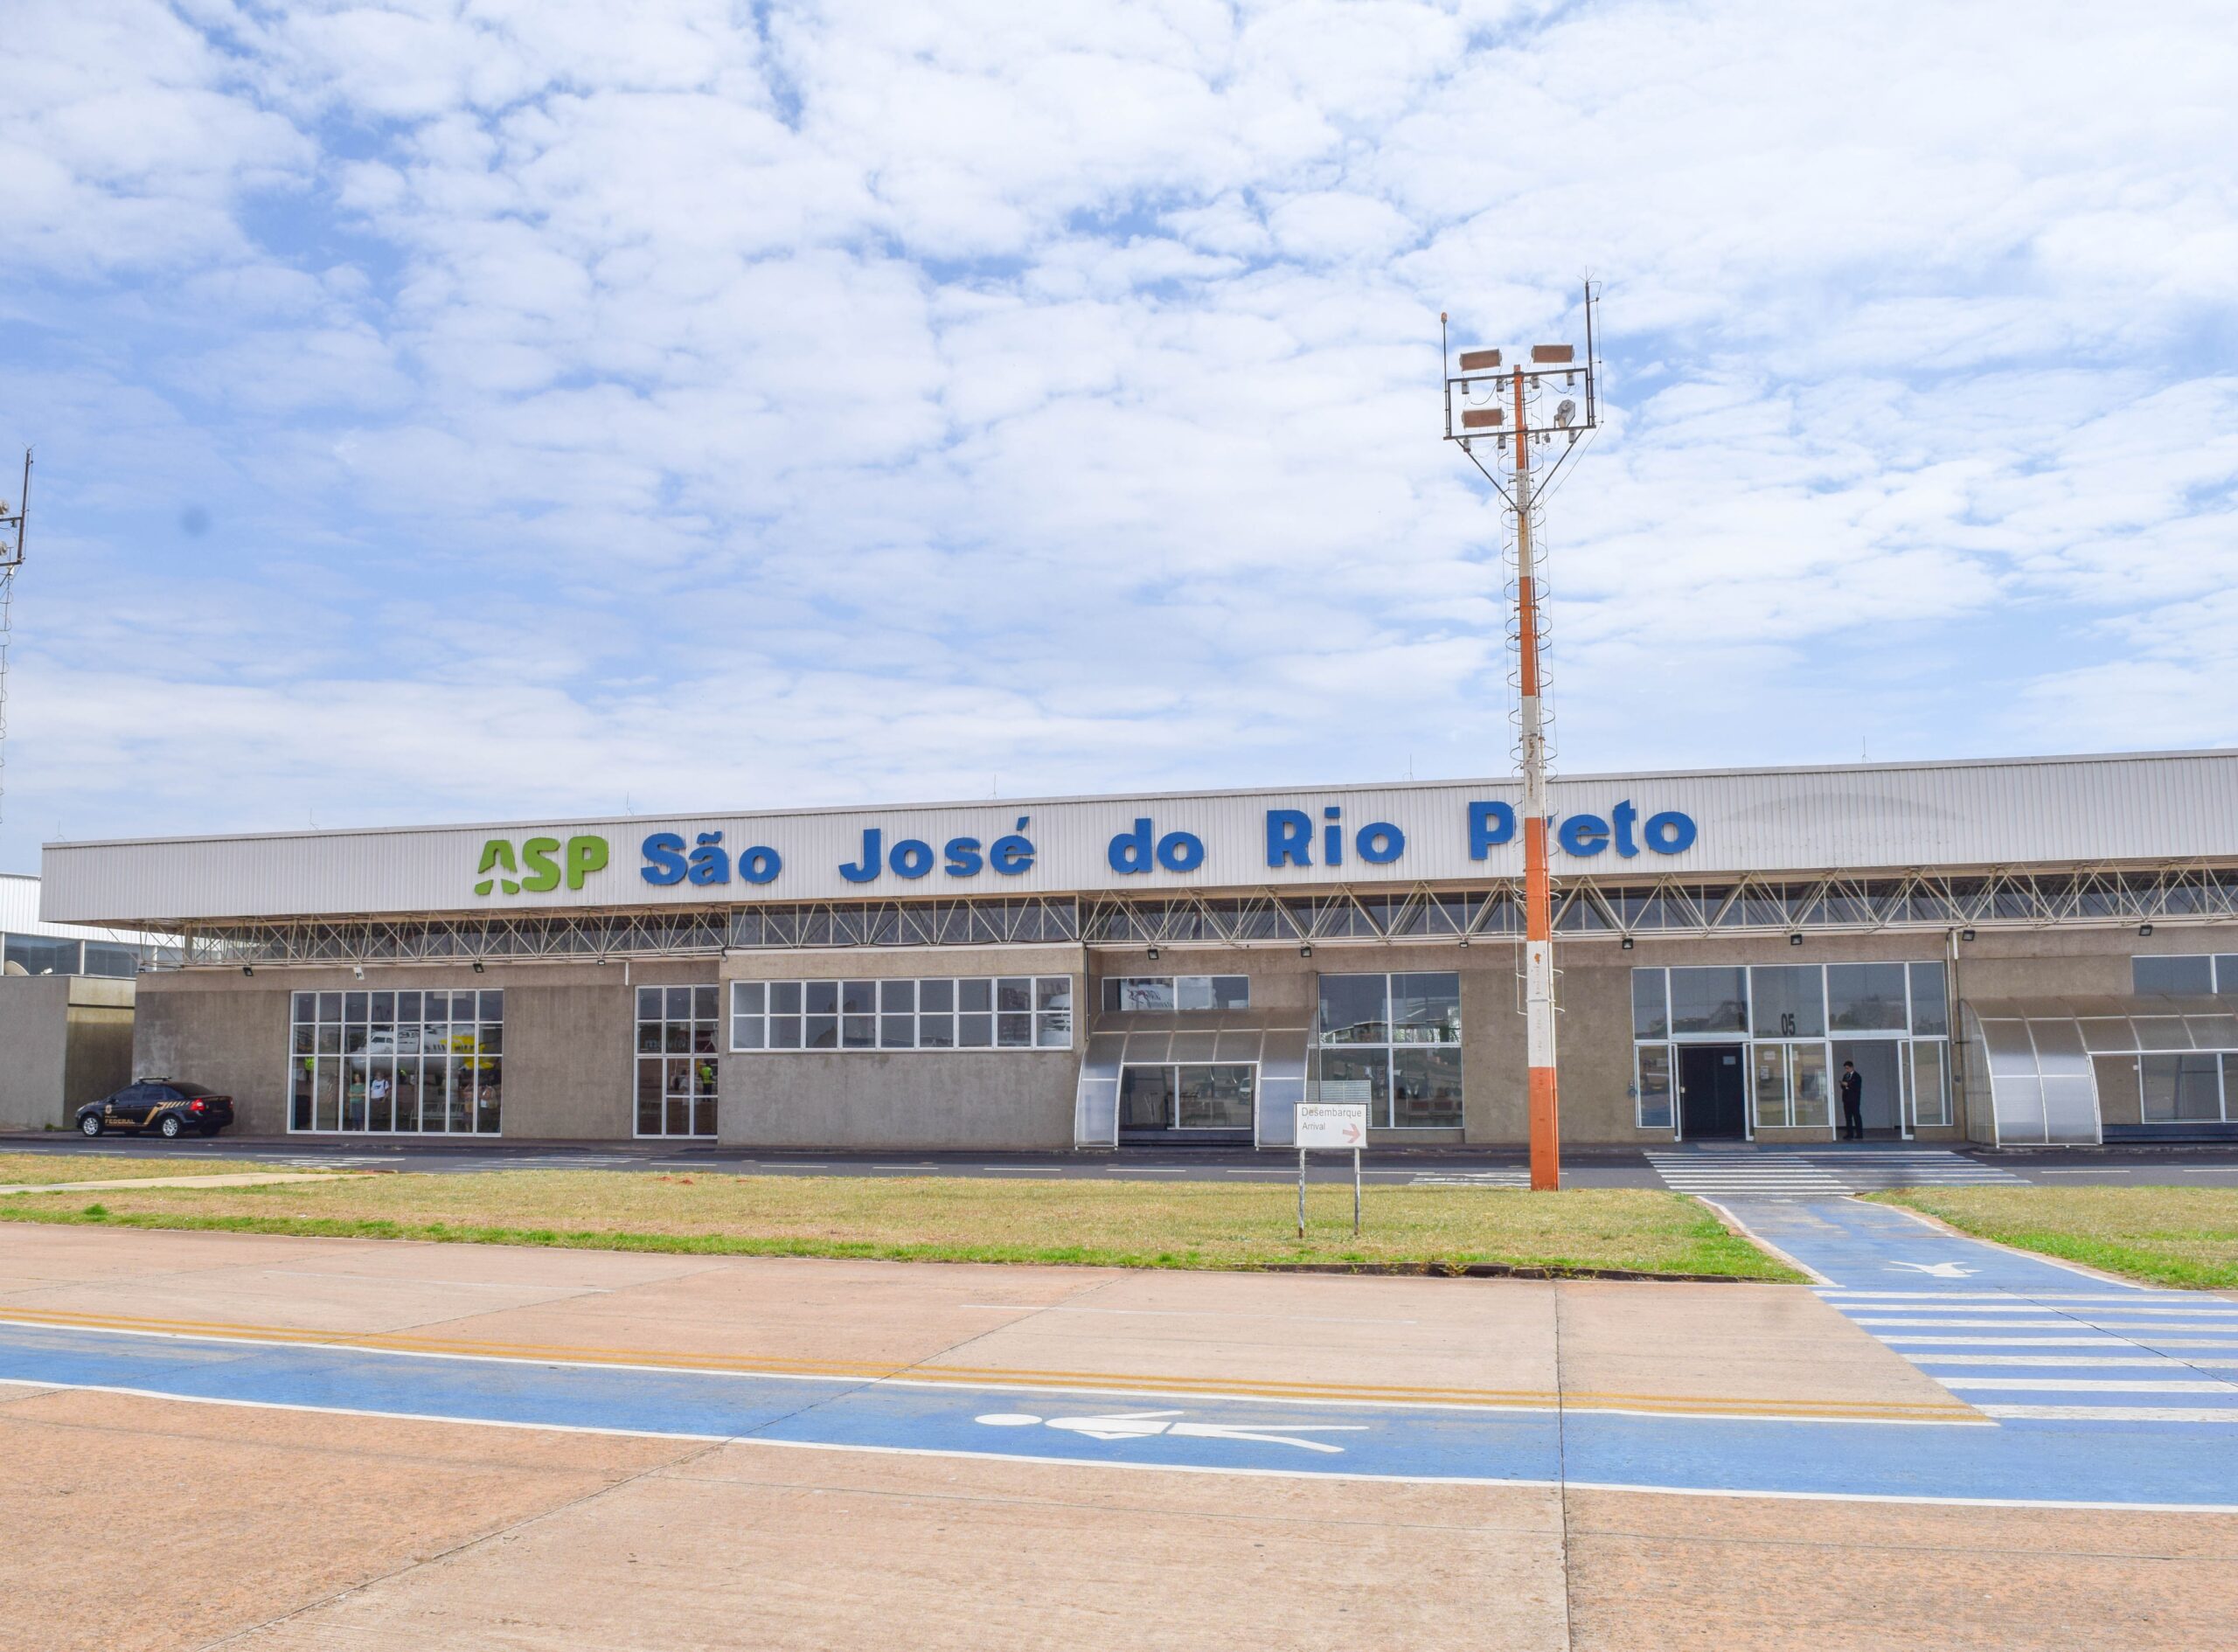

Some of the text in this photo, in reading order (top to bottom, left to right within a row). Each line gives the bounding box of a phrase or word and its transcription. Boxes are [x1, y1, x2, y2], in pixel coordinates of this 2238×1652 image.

[475, 799, 1698, 895] ASP São José do Rio Peto
[1781, 1013, 1796, 1036] 05
[1302, 1107, 1362, 1118] Desembarque
